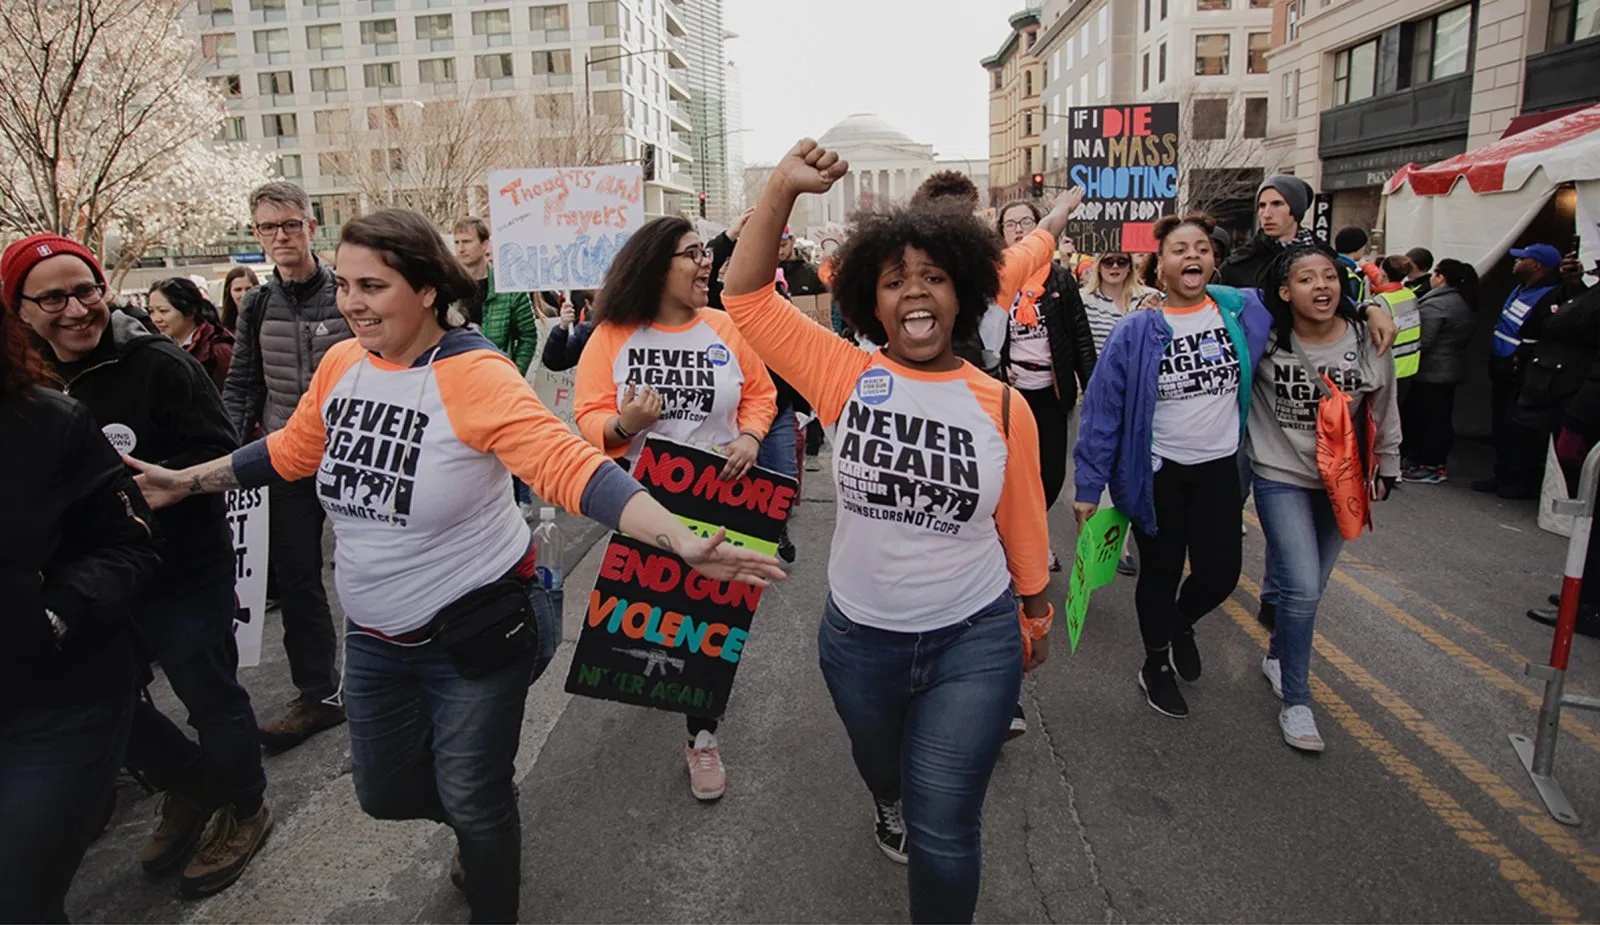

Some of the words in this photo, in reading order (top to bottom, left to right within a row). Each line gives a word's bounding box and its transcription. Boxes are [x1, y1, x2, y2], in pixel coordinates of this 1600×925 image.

[1074, 110, 1088, 129] IF
[1092, 109, 1098, 128] I
[1102, 106, 1152, 138] DIE
[1073, 138, 1090, 158] IN
[1092, 138, 1105, 158] A
[1108, 133, 1176, 167] MASS
[1070, 164, 1177, 199] SHOOTING
[1105, 201, 1128, 220] MY
[1130, 201, 1165, 221] BODY
[1074, 228, 1108, 252] TEPS
[628, 348, 714, 369] NEVER
[625, 367, 714, 387] AGAIN
[326, 398, 429, 444] NEVER
[847, 401, 976, 458] NEVER
[839, 432, 980, 490] AGAIN
[632, 447, 695, 493] NO
[692, 465, 795, 520] MORE
[858, 480, 888, 496] OUR
[600, 543, 681, 592] END
[588, 589, 749, 664] VIOLENCE
[650, 681, 714, 709] AGAIN
